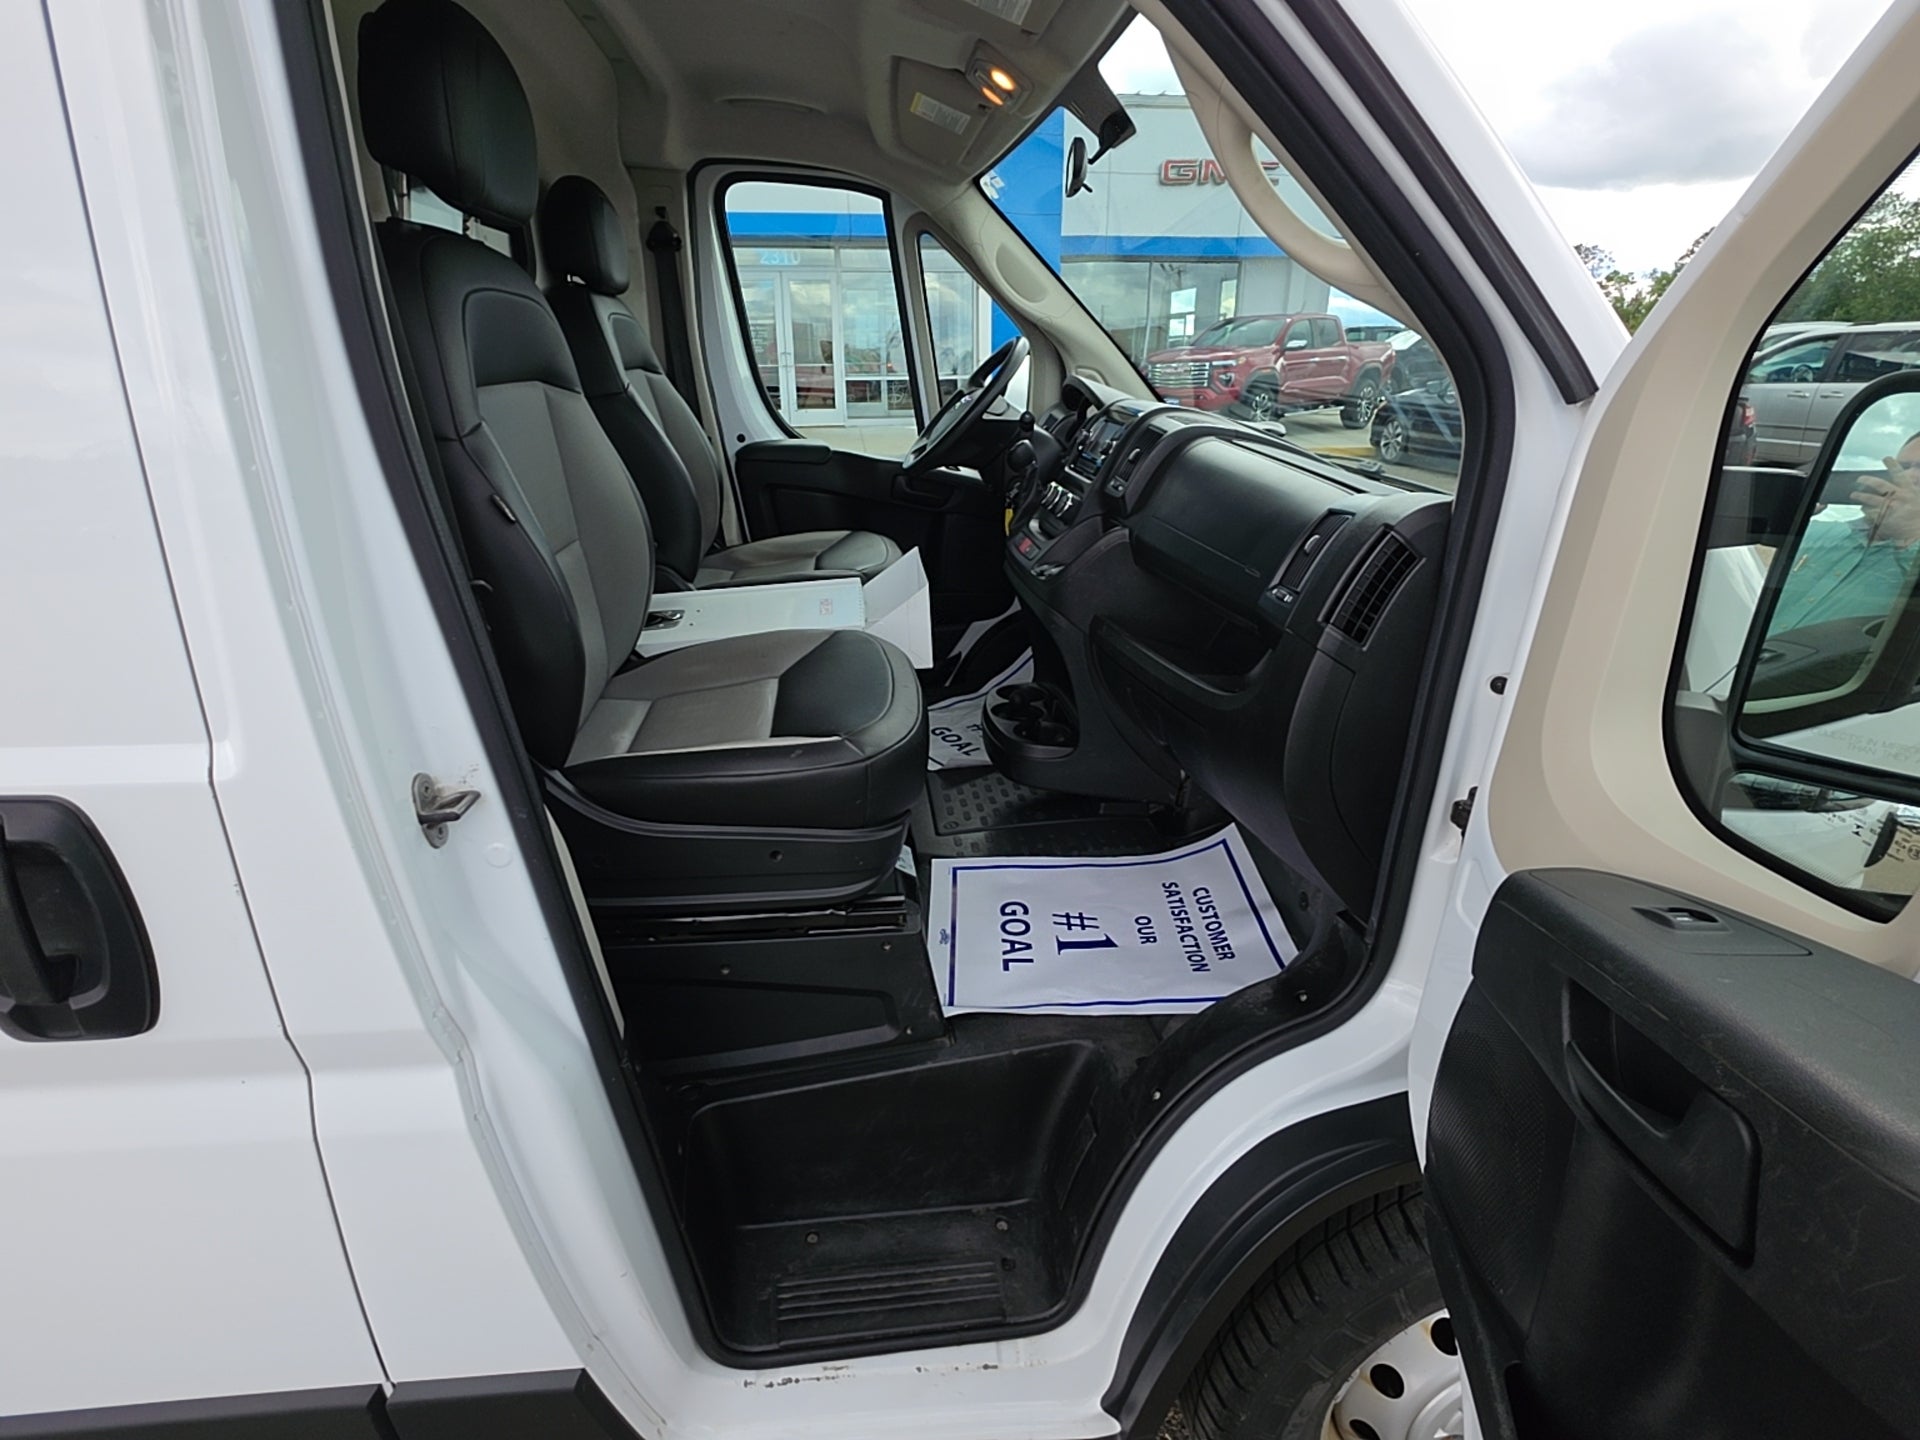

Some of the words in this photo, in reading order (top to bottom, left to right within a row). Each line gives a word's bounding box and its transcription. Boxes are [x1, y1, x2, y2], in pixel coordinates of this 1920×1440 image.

[931, 726, 980, 756] GOAL
[1000, 901, 1034, 971] GOAL
[1052, 912, 1119, 955] #1
[1134, 915, 1157, 944] OUR
[1162, 882, 1211, 972] SATISFACTION
[1192, 887, 1235, 961] CUSTOMER
